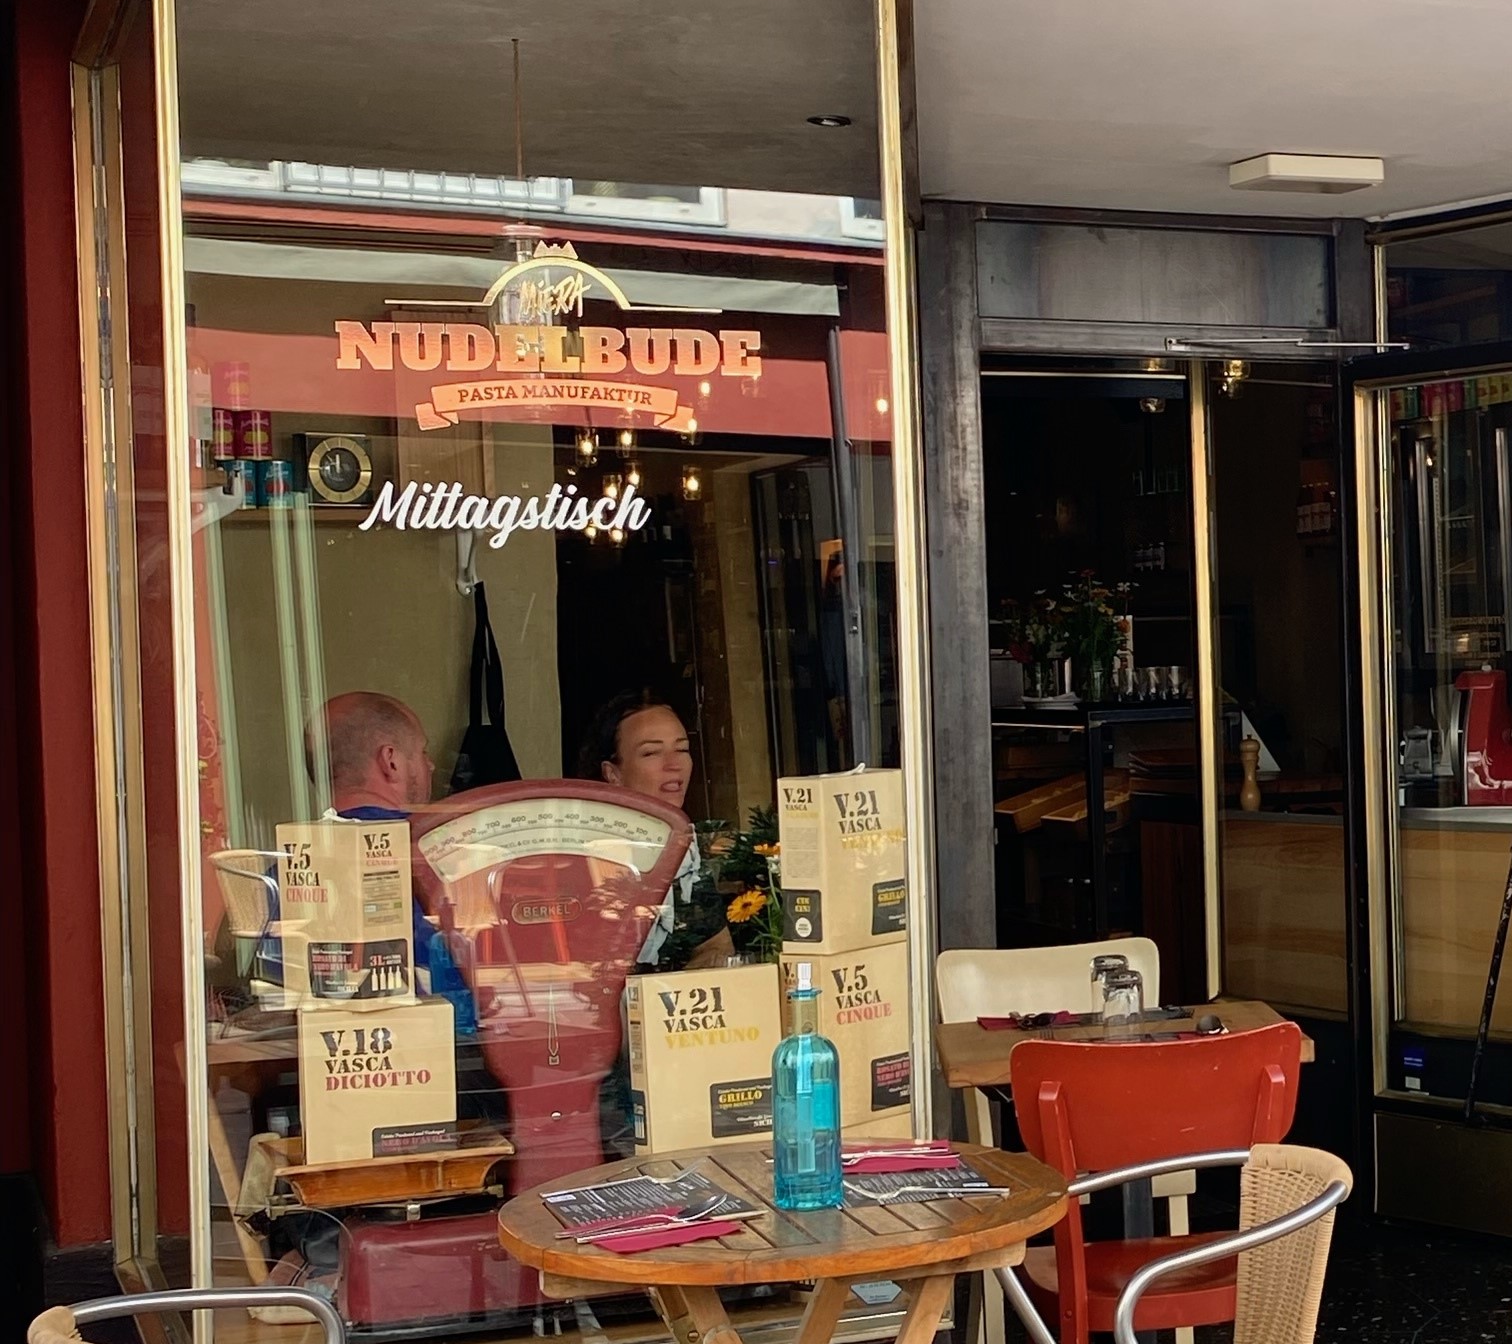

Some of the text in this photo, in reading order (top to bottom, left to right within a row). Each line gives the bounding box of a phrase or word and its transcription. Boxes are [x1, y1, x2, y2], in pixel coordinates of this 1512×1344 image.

[334, 320, 763, 377] NUDELBUDE
[458, 383, 654, 406] PASTA MANUFAKTUR
[358, 480, 652, 549] Mittagstisch
[783, 788, 813, 804] V.21
[834, 790, 880, 818] V.21
[838, 817, 882, 834] VASCA
[363, 833, 390, 851] V.5
[284, 843, 311, 870] V.5
[286, 872, 320, 887] VASCA
[286, 888, 328, 903] CINQUE
[522, 906, 571, 918] BERKEL
[831, 964, 868, 993] V.5
[658, 987, 725, 1017] V.21
[836, 990, 881, 1009] VASCA
[663, 1014, 726, 1033] VASCA
[836, 1003, 892, 1025] CINQUE
[320, 1028, 392, 1057] V.18
[665, 1027, 760, 1049] VENTUNO
[325, 1056, 393, 1074] VASCA
[326, 1069, 431, 1091] DICIOTTO
[719, 1090, 762, 1103] GRILLO
